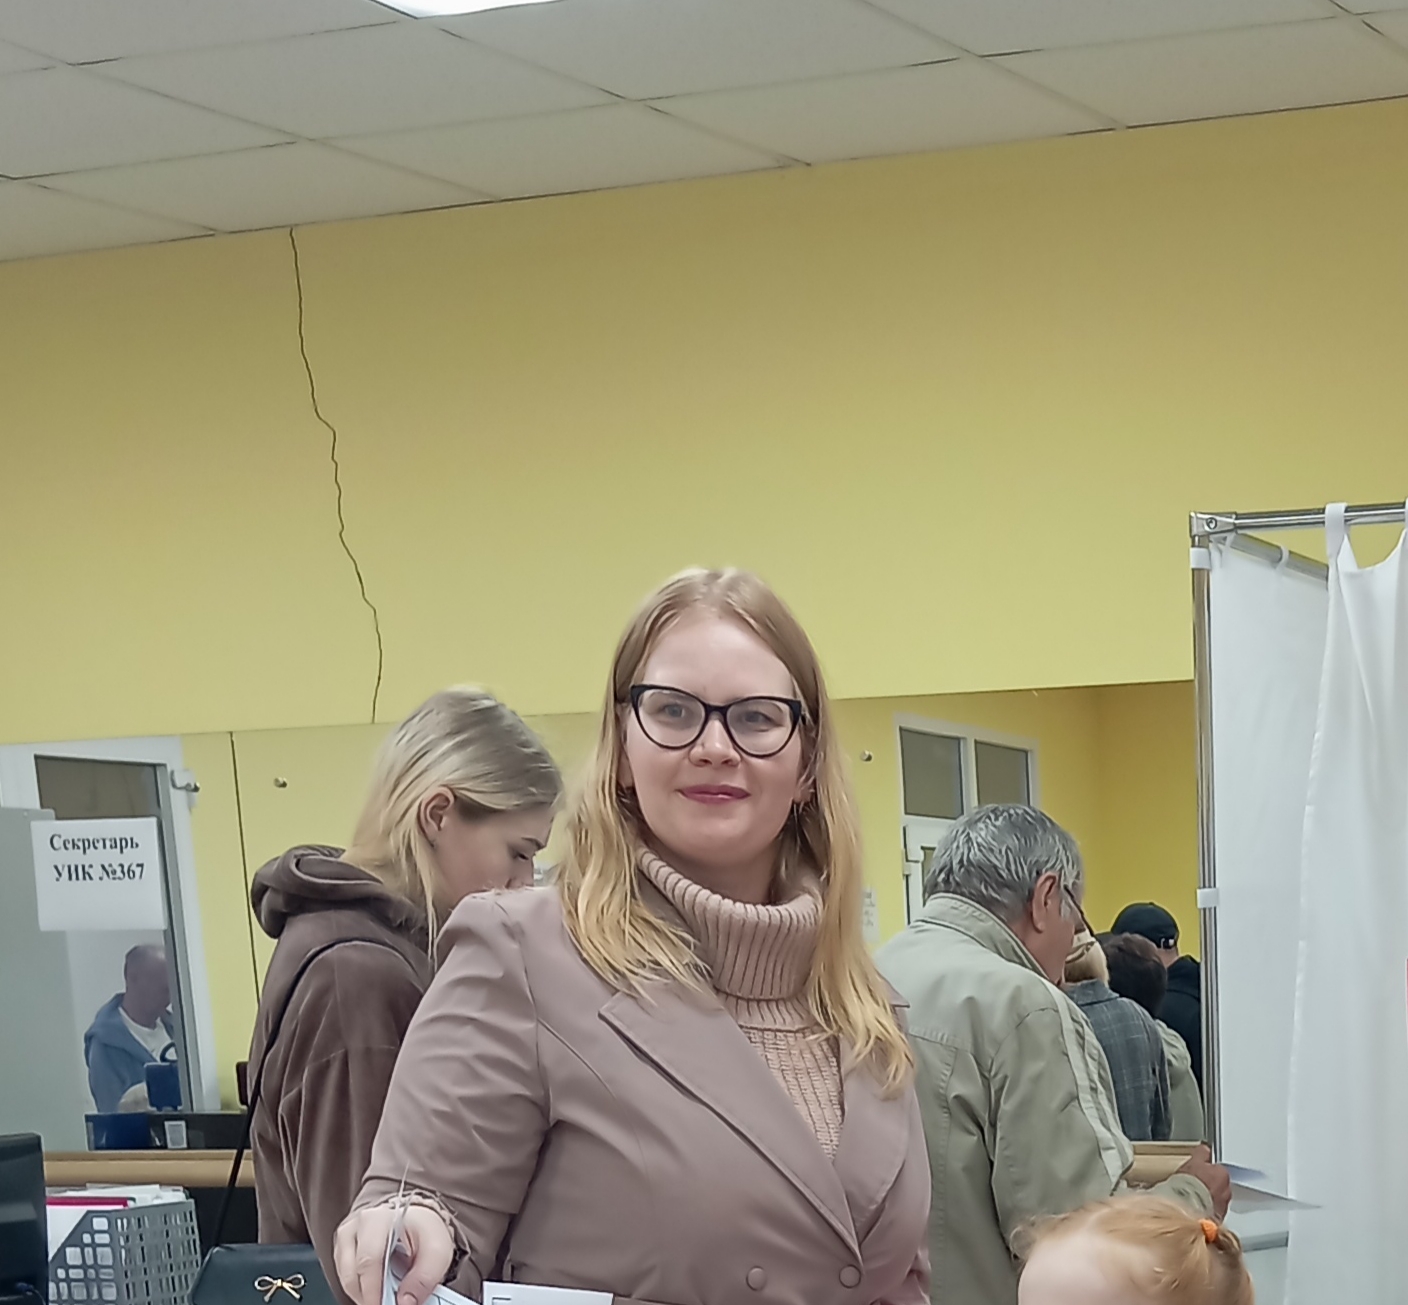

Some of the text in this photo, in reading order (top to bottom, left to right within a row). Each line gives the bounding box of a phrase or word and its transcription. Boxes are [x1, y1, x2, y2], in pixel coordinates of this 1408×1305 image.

[49, 833, 140, 855] Секретарь
[53, 862, 145, 882] УИК №367
